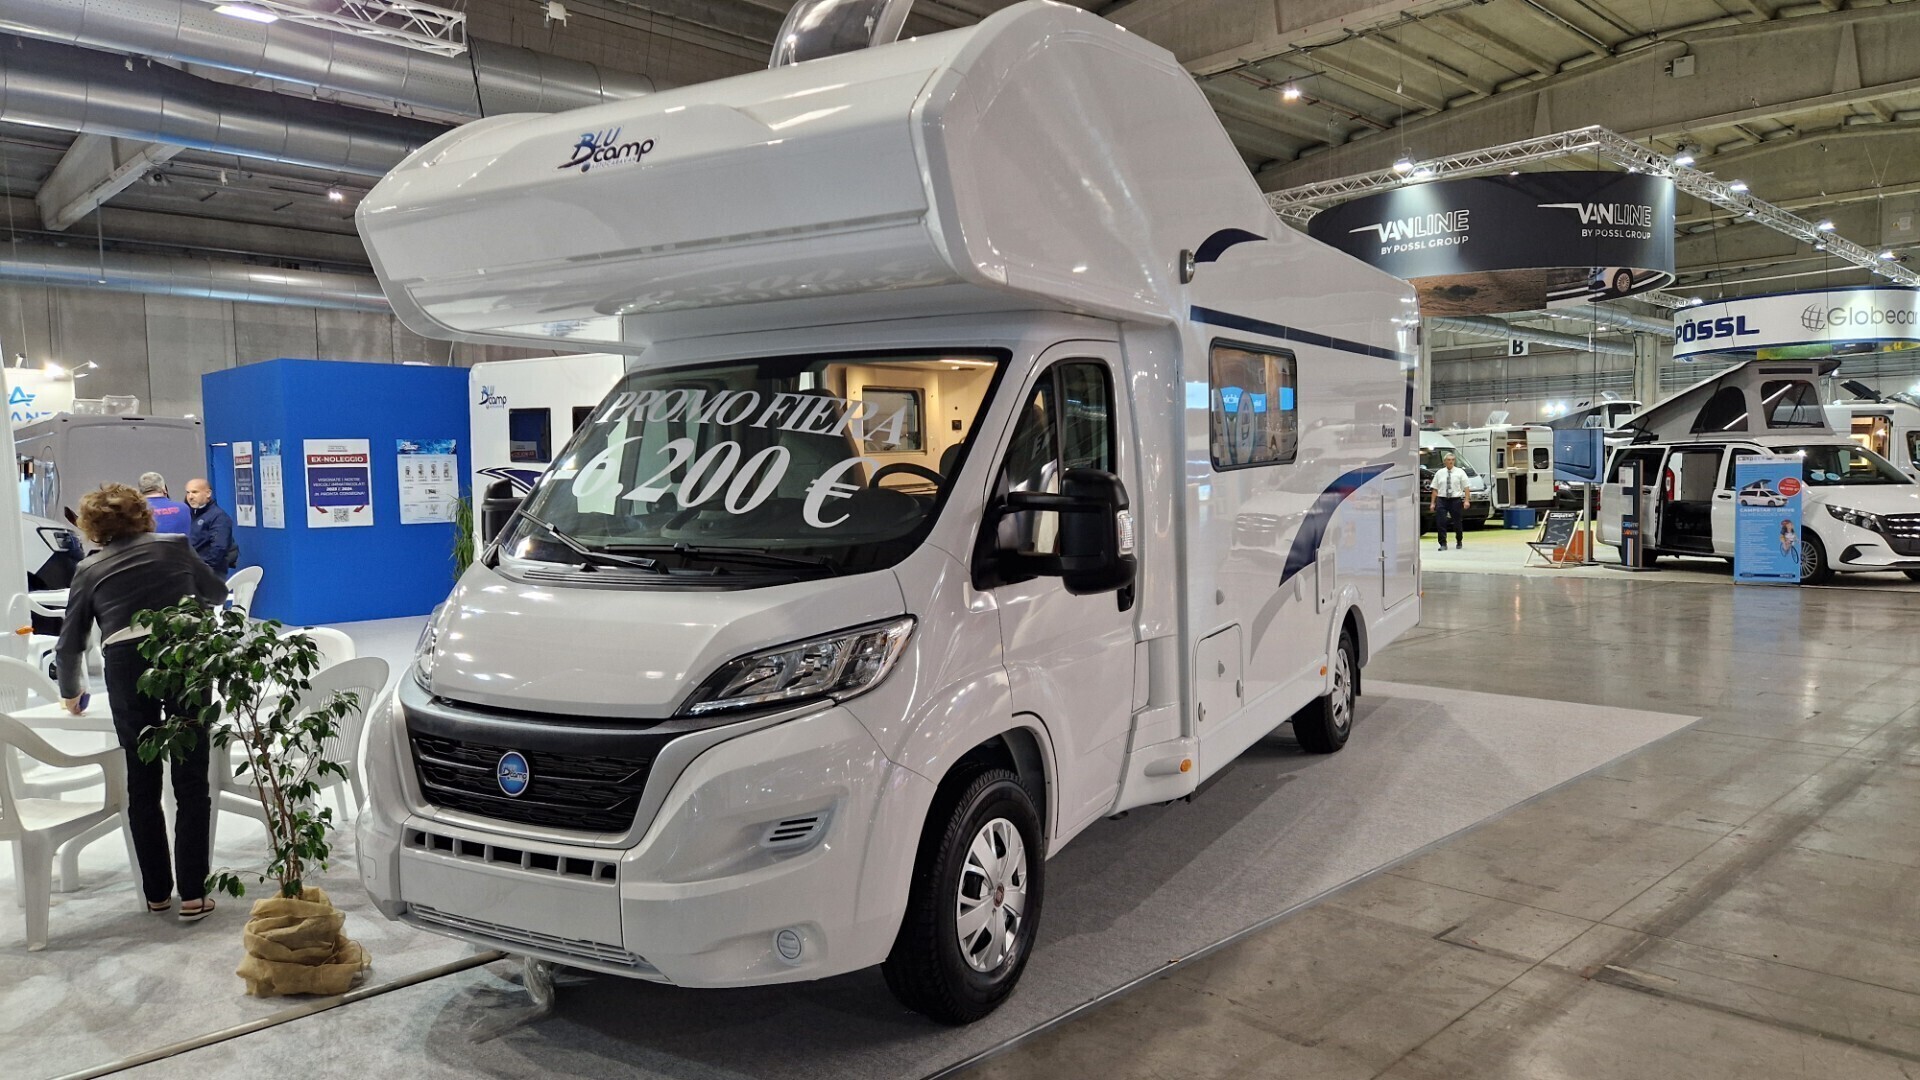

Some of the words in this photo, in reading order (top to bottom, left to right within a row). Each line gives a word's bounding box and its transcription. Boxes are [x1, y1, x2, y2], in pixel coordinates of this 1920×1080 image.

[593, 138, 655, 163] camp
[1377, 209, 1470, 244] VANLINE
[1577, 203, 1652, 228] VANLINE
[1381, 246, 1393, 256] BY
[1428, 235, 1469, 248] GROUP
[1581, 228, 1594, 237] BY
[1625, 230, 1651, 240] GROUP
[1675, 315, 1760, 345] PÖSSL
[1512, 339, 1524, 355] B
[595, 388, 760, 426] PROMO
[749, 392, 907, 446] FIERA
[1382, 424, 1396, 438] Ocean
[803, 456, 880, 529] €
[153, 507, 180, 515] TAFF
